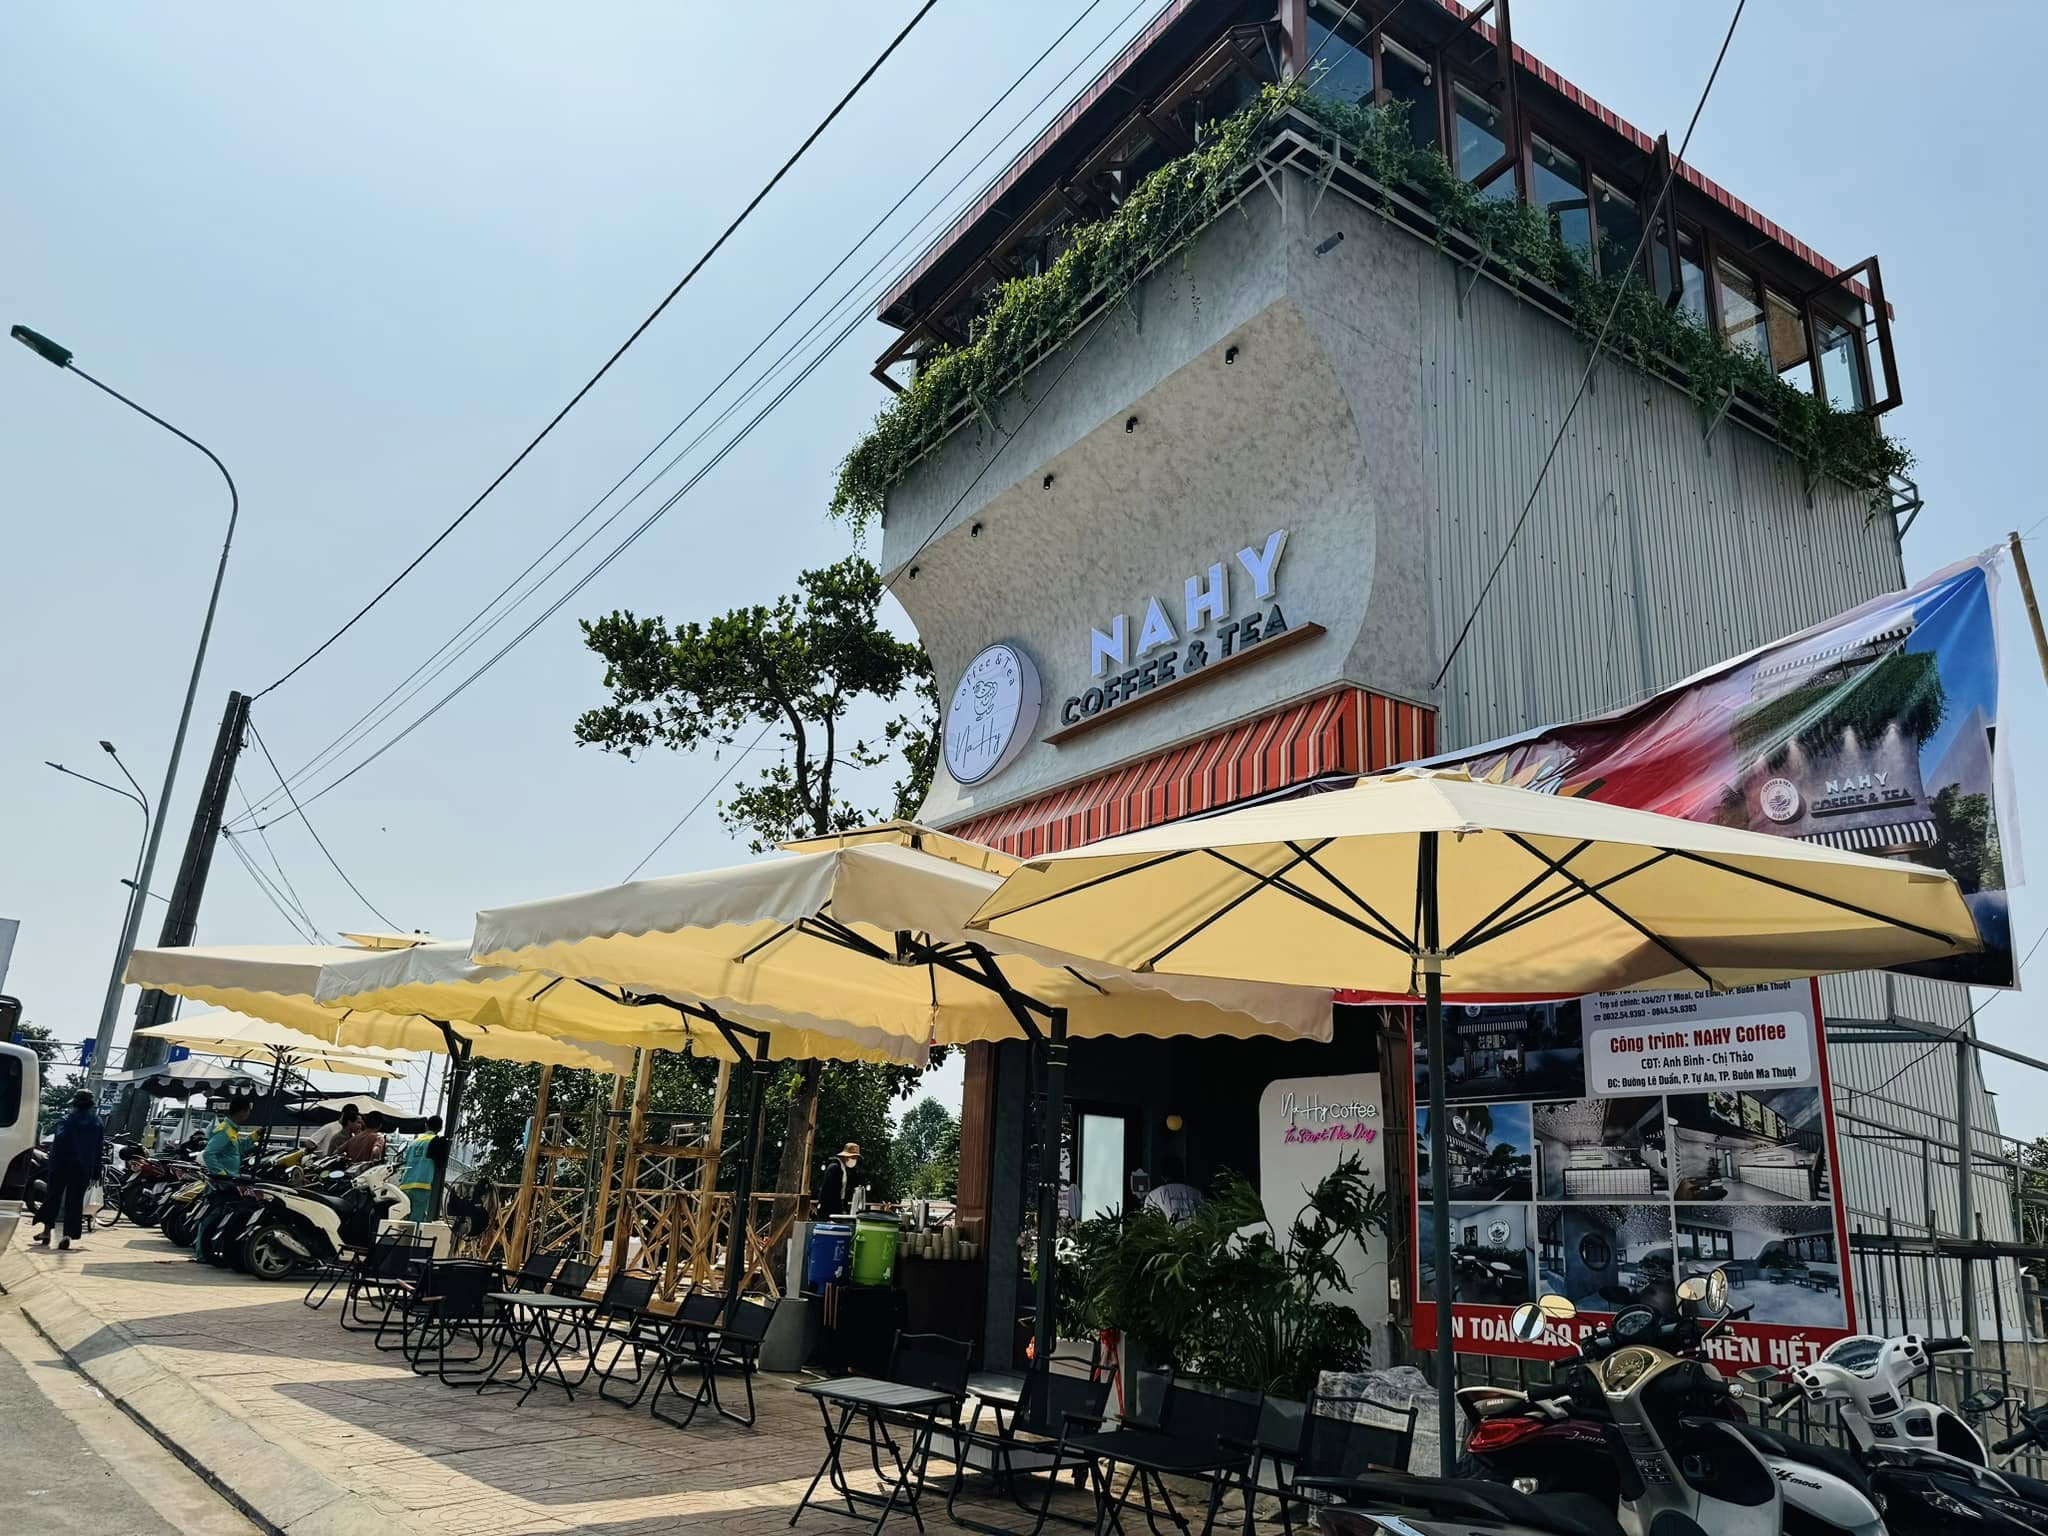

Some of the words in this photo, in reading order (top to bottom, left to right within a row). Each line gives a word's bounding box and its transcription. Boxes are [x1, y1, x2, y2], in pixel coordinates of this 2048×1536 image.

[1091, 528, 1288, 678] NAHY
[1060, 651, 1178, 726] COFFEE
[1183, 639, 1208, 674] &
[1216, 603, 1288, 659] TEA
[954, 659, 991, 712] Coffee
[995, 653, 1003, 667] &
[1003, 656, 1017, 687] Tea
[1825, 772, 1888, 794] NAHY
[1811, 795, 1867, 811] COFFEE
[1881, 787, 1912, 802] TEA
[1610, 1037, 1644, 1053] Công
[1648, 1031, 1689, 1050] trình:
[1693, 1027, 1731, 1046] NAHY
[1736, 1024, 1786, 1043] Coffee
[1641, 1057, 1661, 1069] CĐT:
[1663, 1055, 1681, 1068] Anh
[1683, 1053, 1705, 1067] Bình
[1712, 1052, 1728, 1067] Chị
[1729, 1050, 1754, 1064] Thảo
[1647, 1074, 1657, 1086] Lê
[1683, 1073, 1690, 1083] P.
[1703, 1071, 1717, 1083] An,
[1718, 1070, 1731, 1081] TP.
[1732, 1068, 1754, 1081] Buôn
[1755, 1068, 1770, 1079] Ma
[1771, 1066, 1797, 1081] Thuột
[1330, 1103, 1377, 1118] Coffee
[1328, 1124, 1351, 1141] The
[1353, 1122, 1376, 1143] Day
[1534, 1324, 1572, 1347] AO
[1790, 1478, 1822, 1490] mode
